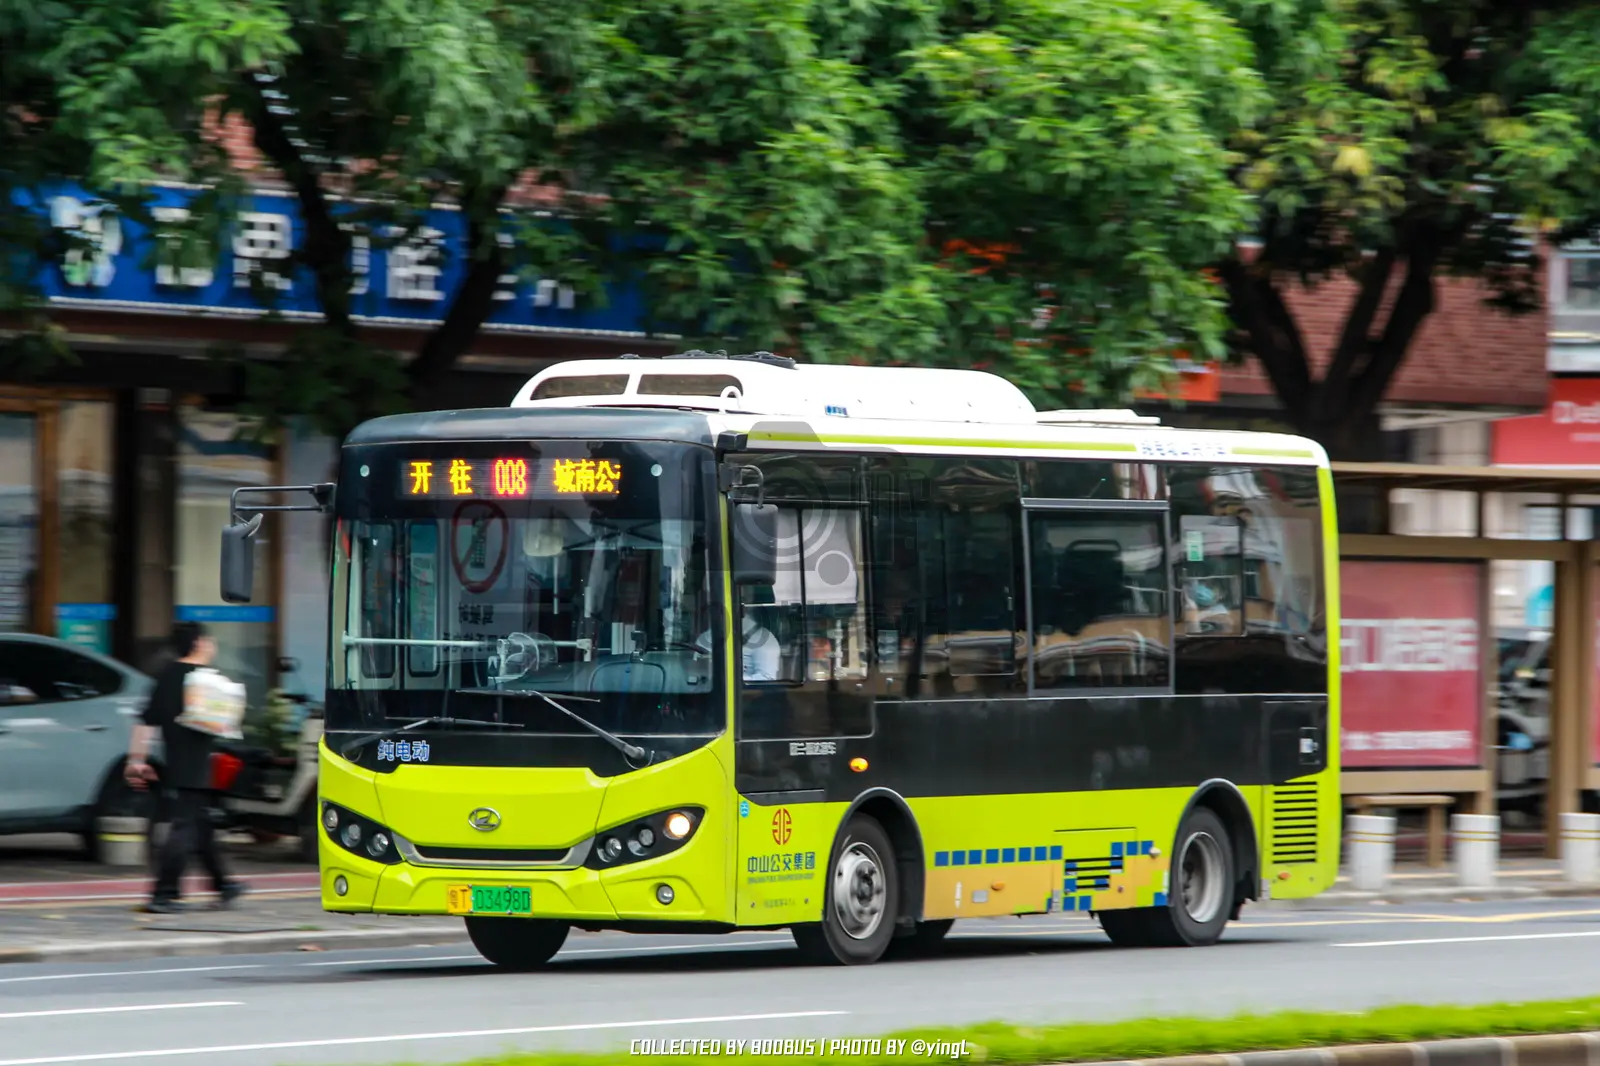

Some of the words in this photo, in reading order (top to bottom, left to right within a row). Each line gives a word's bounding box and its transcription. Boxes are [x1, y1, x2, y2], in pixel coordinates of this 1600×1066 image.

[494, 459, 527, 494] 008
[553, 459, 621, 494] 城南公
[377, 739, 430, 762] 纯电动
[747, 852, 816, 874] 中山公交集团
